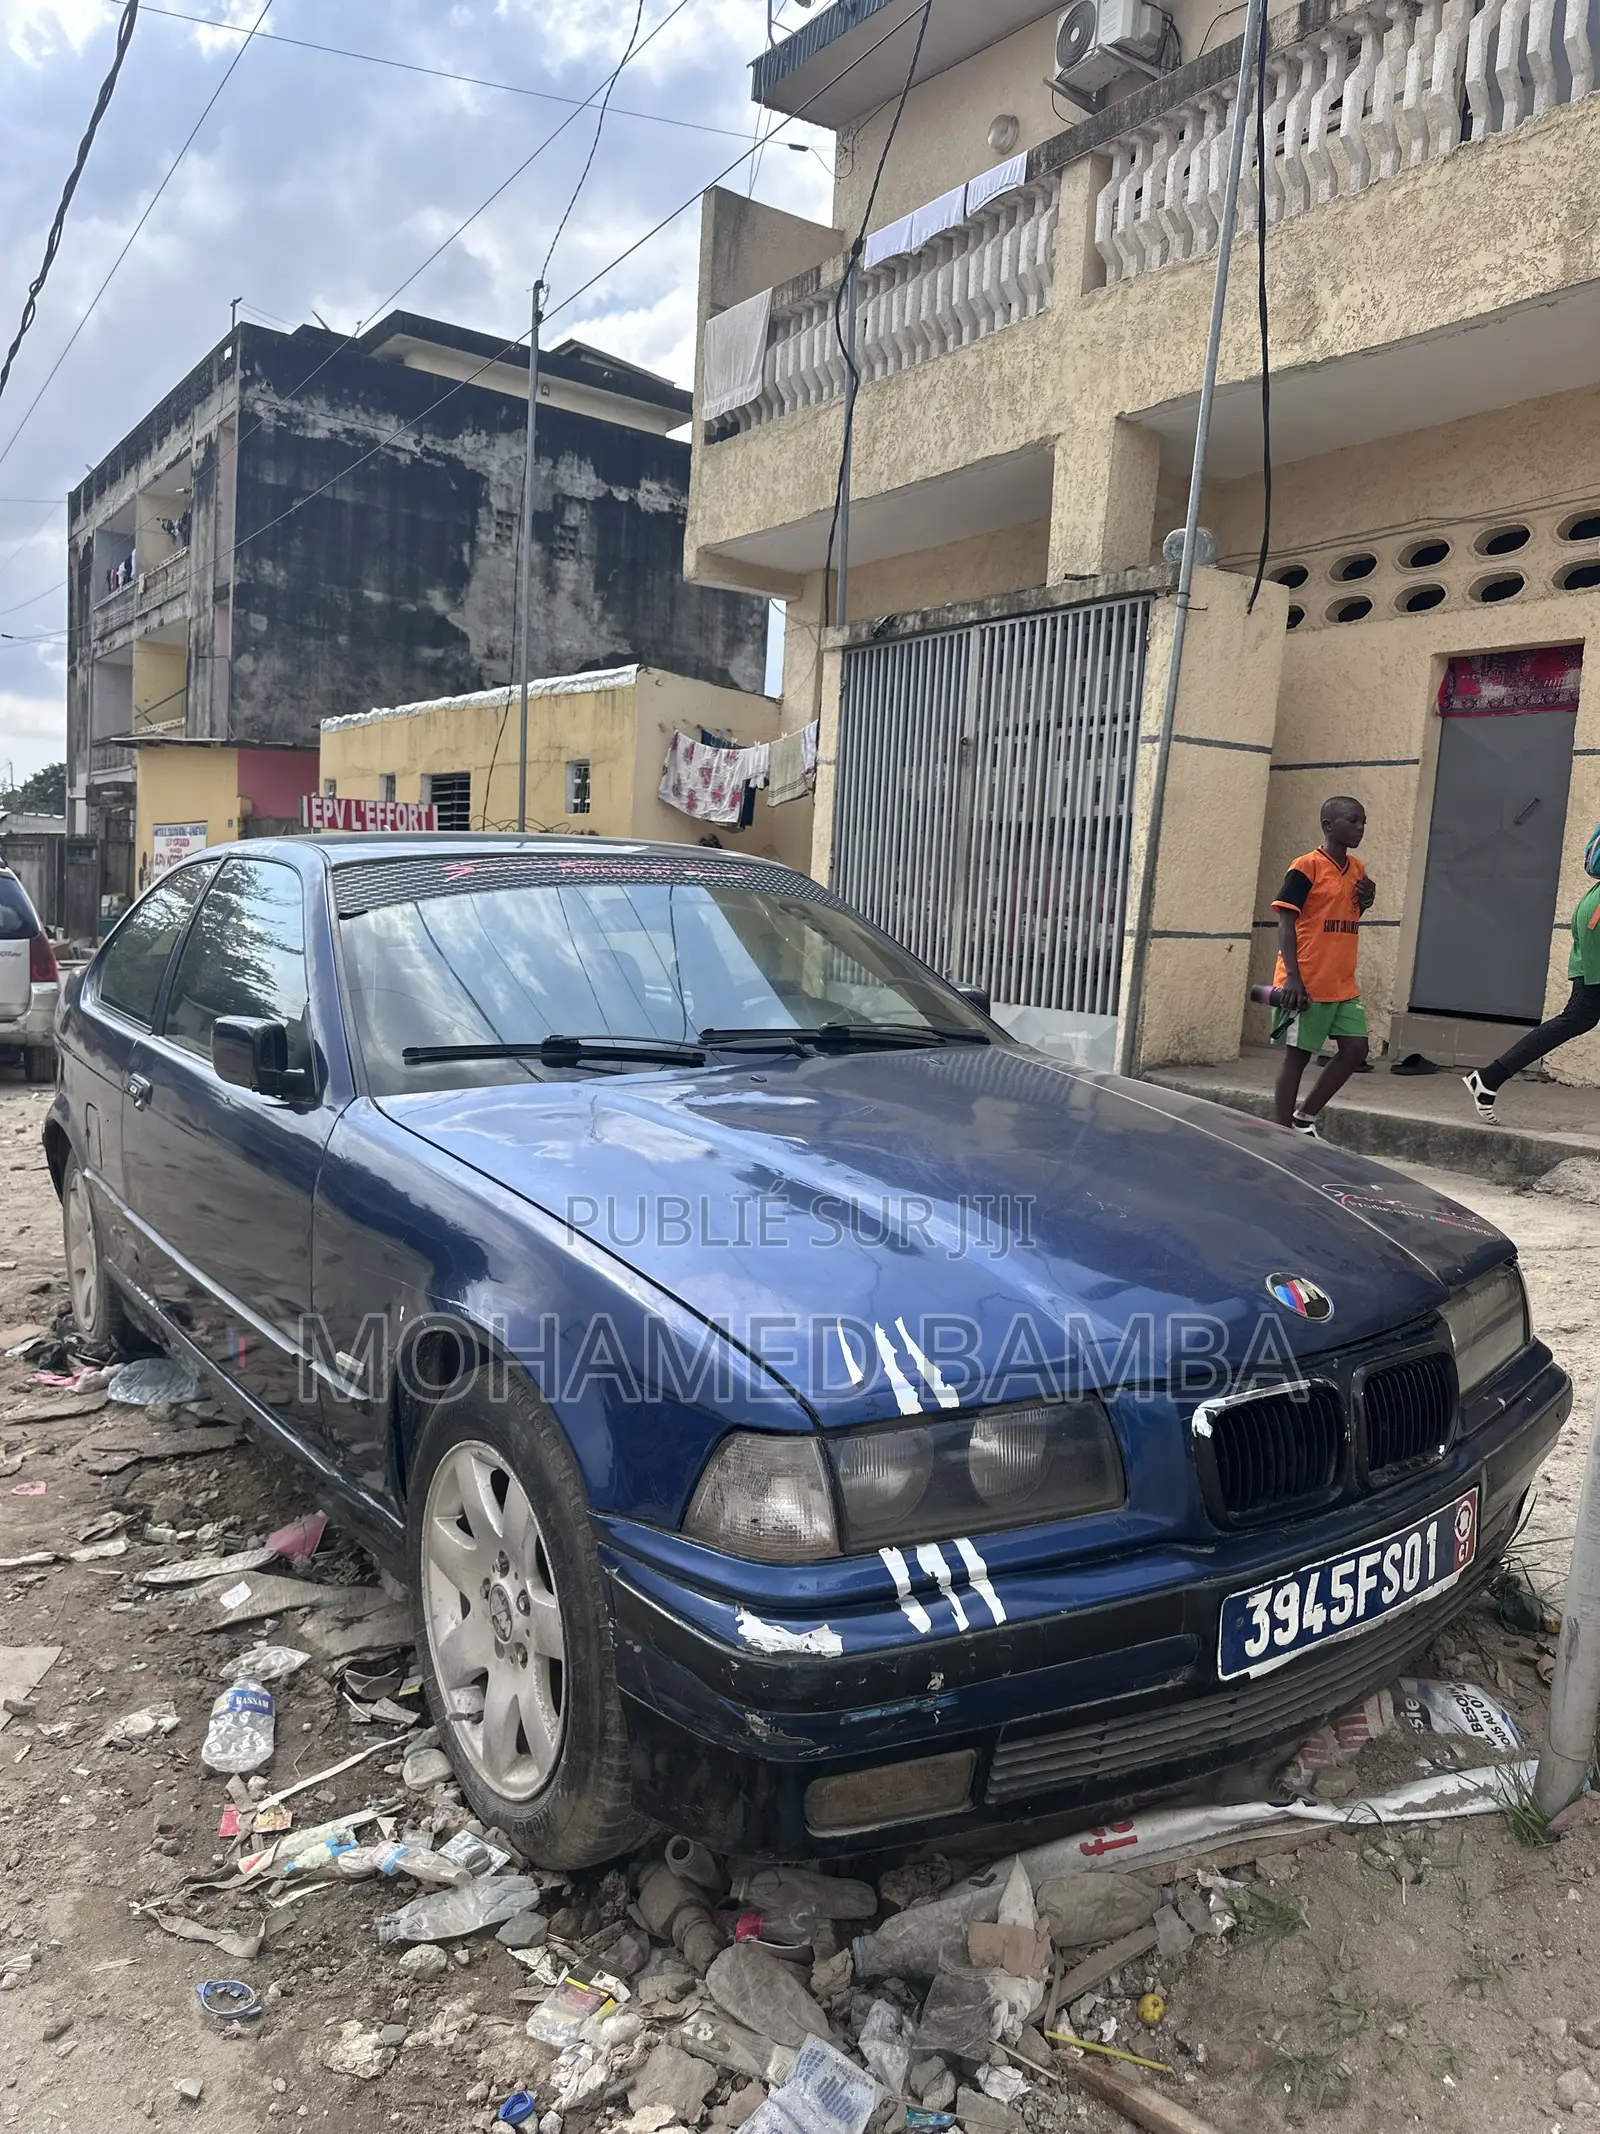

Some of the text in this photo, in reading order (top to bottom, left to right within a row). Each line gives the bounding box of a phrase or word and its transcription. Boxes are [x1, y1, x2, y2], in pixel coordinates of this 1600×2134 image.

[351, 800, 429, 831] L'EFFORT
[560, 866, 643, 875] POWERED
[1244, 1520, 1438, 1658] 3945FS01
[1480, 1710, 1499, 1726] AU
